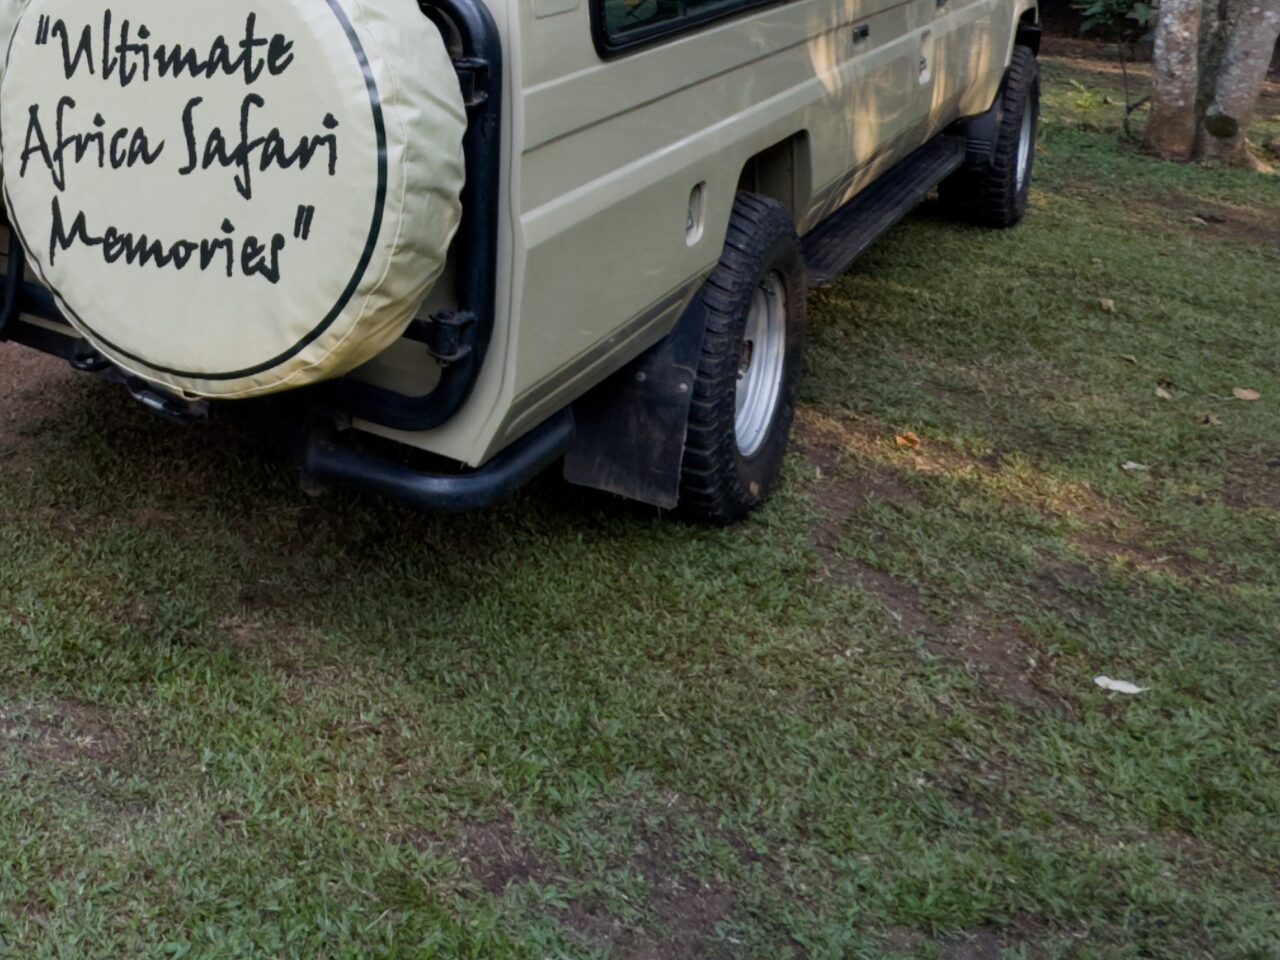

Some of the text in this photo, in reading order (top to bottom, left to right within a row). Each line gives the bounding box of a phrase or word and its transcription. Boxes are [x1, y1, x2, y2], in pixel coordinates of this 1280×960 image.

[35, 8, 295, 88] "Ultimate
[19, 92, 340, 201] Africa Safari
[49, 194, 316, 285] Memories"
